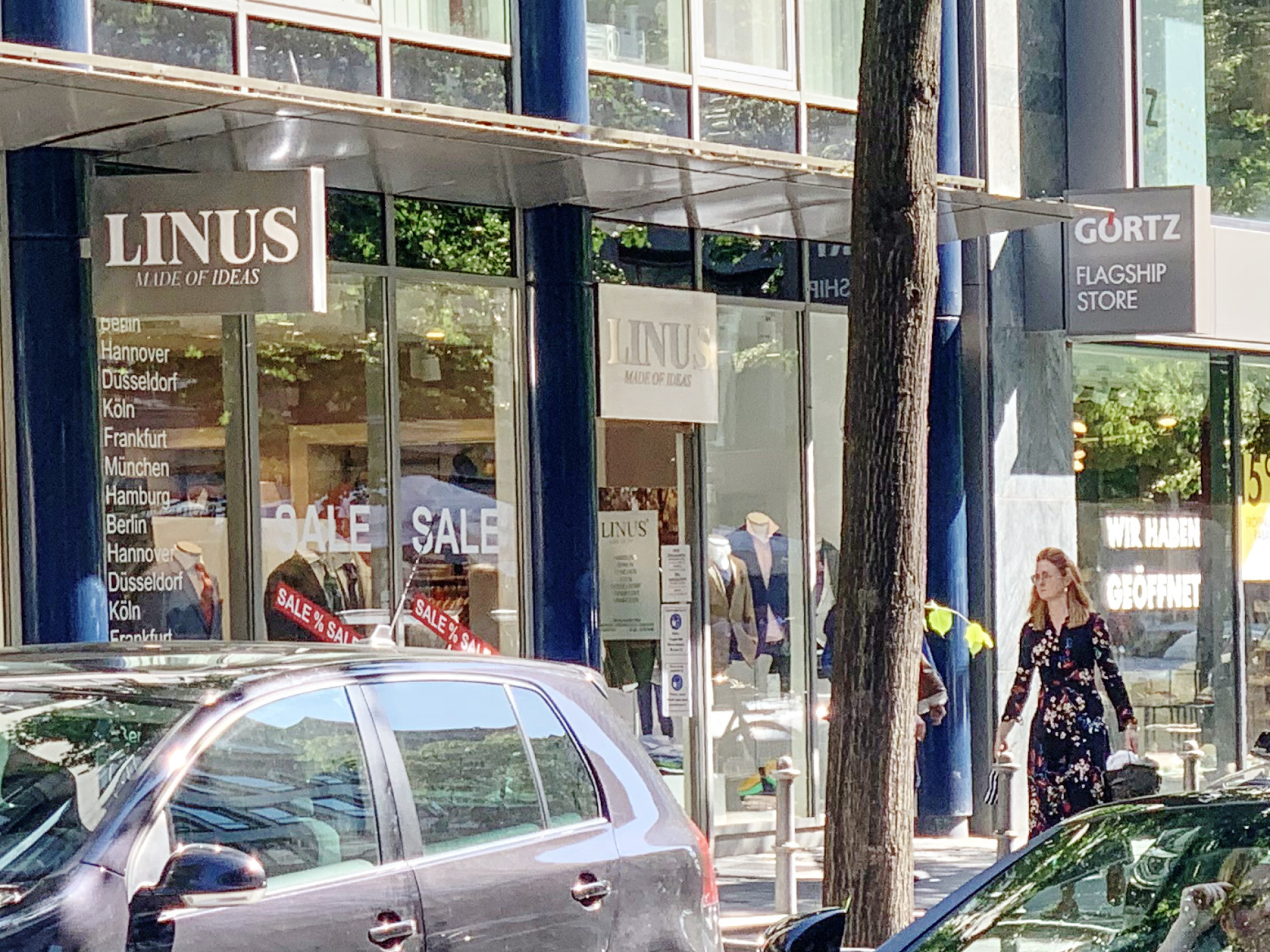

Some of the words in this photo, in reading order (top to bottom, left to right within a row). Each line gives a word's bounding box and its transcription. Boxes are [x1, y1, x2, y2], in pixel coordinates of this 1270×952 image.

[104, 206, 299, 267] LINUS
[135, 270, 182, 287] MADE
[185, 269, 209, 286] OF
[212, 268, 261, 286] IDEAS
[1076, 263, 1167, 286] FLAGSHIP
[1077, 289, 1138, 312] STORE
[101, 340, 170, 363] Hannover
[606, 318, 715, 371] LINUS
[624, 370, 651, 385] MADE
[652, 371, 665, 386] OF
[666, 372, 692, 387] IDEAS
[103, 397, 135, 418] Köln
[104, 426, 168, 449] Frankfurt
[104, 455, 170, 477] München
[105, 484, 170, 509] Hamburg
[106, 513, 147, 535] Berlin
[275, 503, 371, 554] SALE
[412, 505, 499, 555] SALE
[601, 520, 648, 538] LINUS
[1105, 516, 1143, 549] WIR
[1144, 516, 1201, 549] HABEN
[107, 542, 174, 563] Hannover
[108, 570, 183, 592] Düsseldorf
[1106, 564, 1202, 611] GEÖFFNET
[109, 600, 141, 621] Köln
[276, 586, 313, 623] SALE
[313, 610, 325, 633] %
[414, 598, 448, 635] SALE
[448, 622, 459, 644] %
